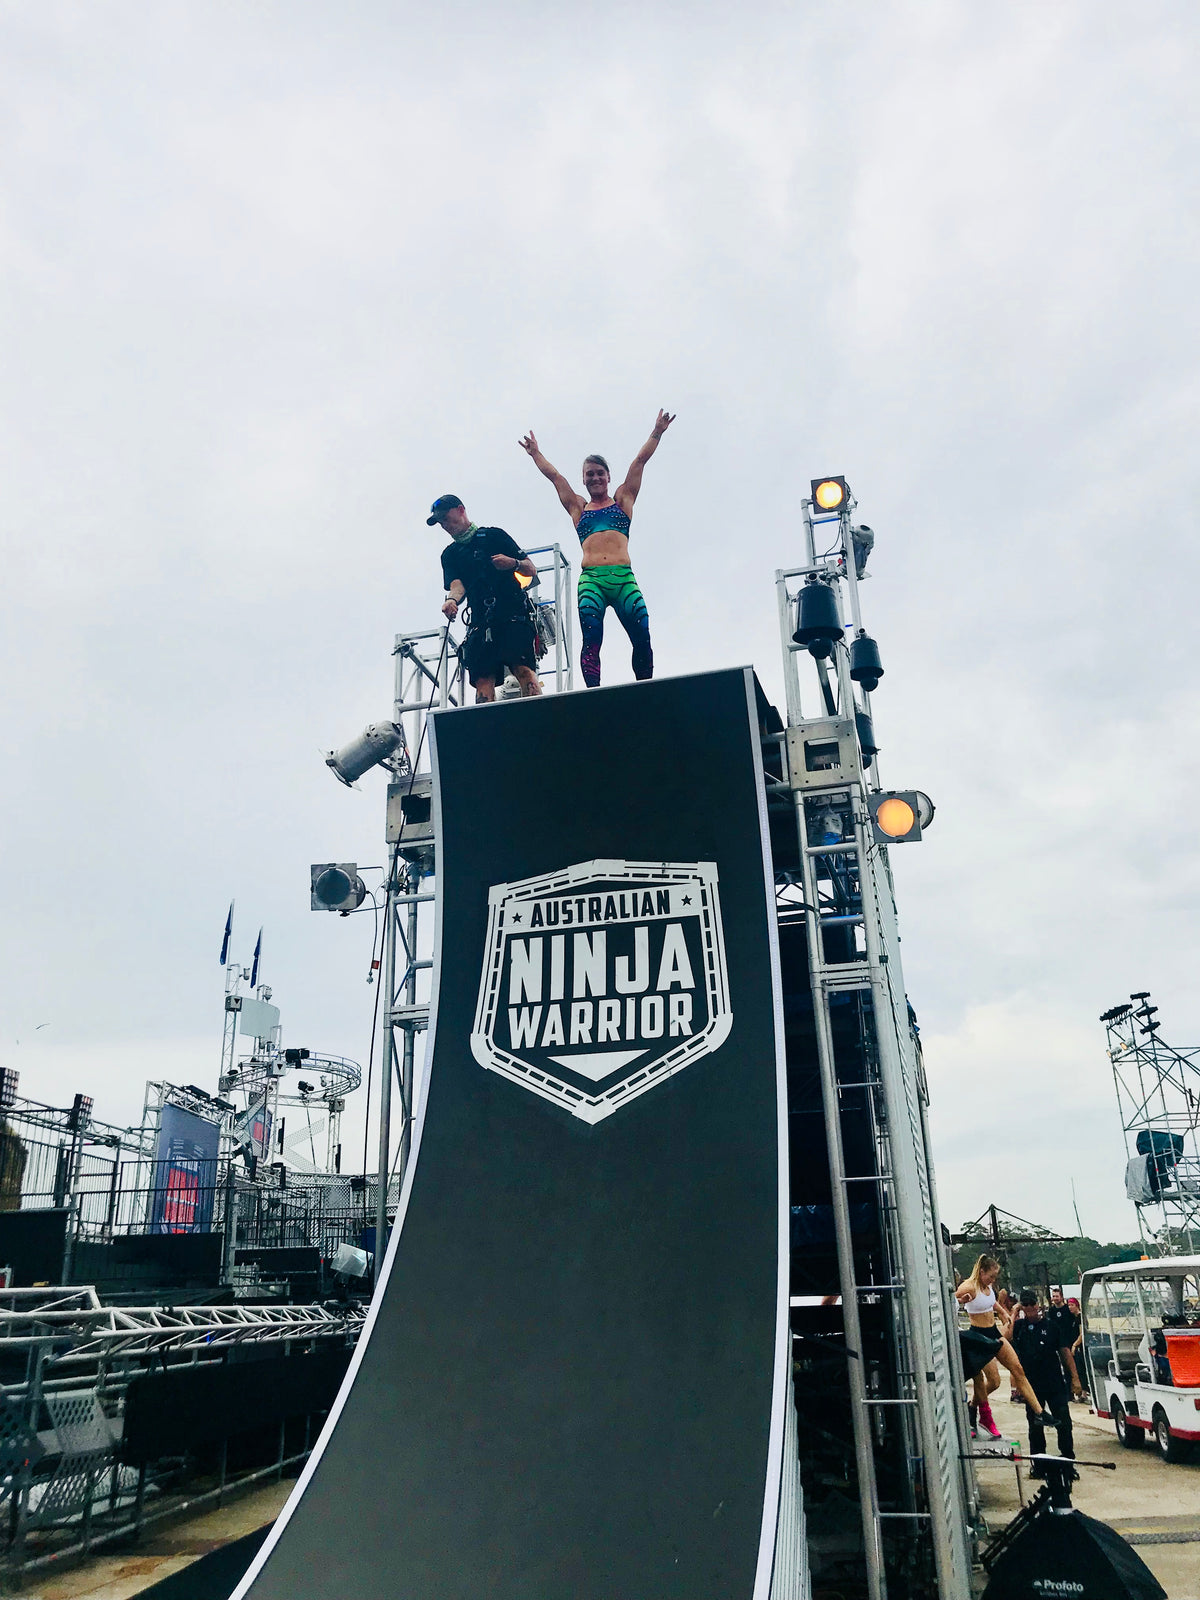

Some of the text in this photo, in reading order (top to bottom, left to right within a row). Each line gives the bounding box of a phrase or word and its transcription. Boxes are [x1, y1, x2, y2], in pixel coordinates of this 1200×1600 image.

[530, 889, 671, 928] AUSTRALIAN
[509, 923, 696, 1005] NINJA
[508, 993, 694, 1050] WARRIOR
[1043, 1579, 1084, 1593] Profoto
